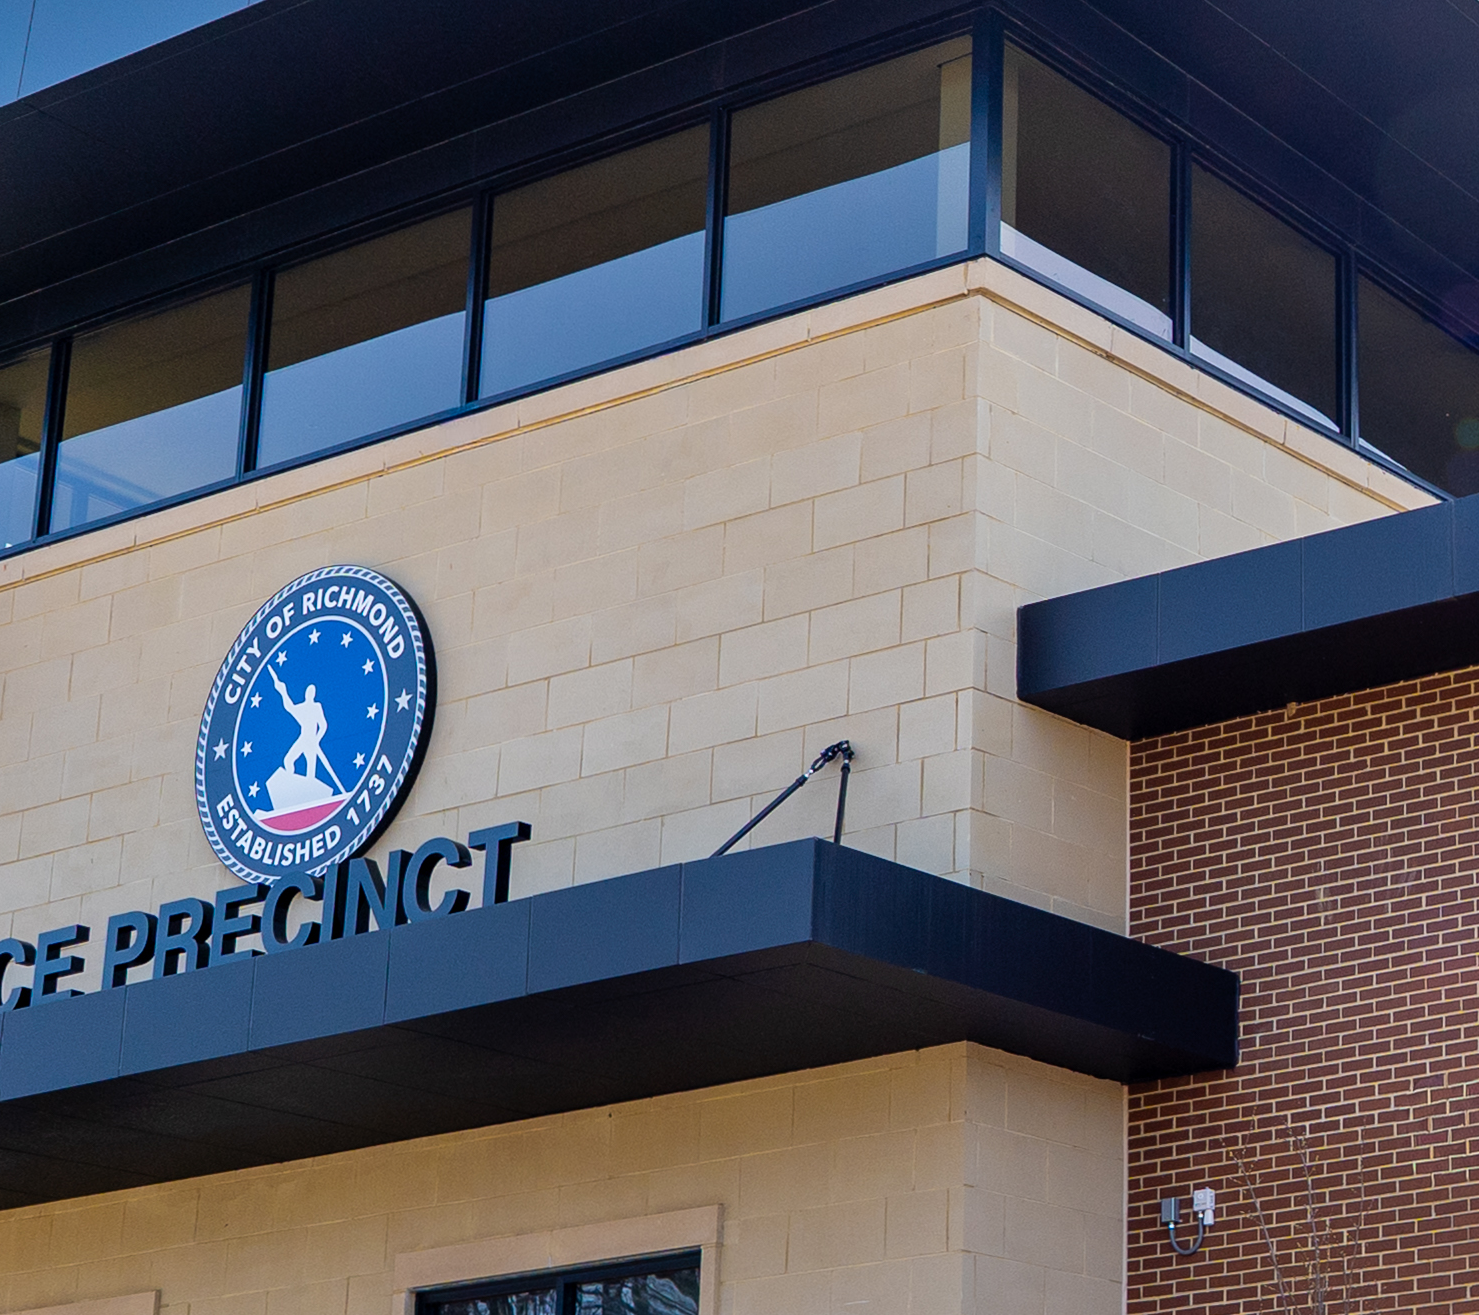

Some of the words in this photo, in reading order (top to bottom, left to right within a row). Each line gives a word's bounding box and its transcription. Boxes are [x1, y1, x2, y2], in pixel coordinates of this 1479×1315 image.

[224, 636, 263, 705] CITY
[265, 602, 296, 639] OF
[301, 585, 406, 659] RICHMOND
[216, 793, 342, 867] ESTABLISHED
[346, 754, 394, 826] 1737
[101, 821, 531, 991] PRECINCT
